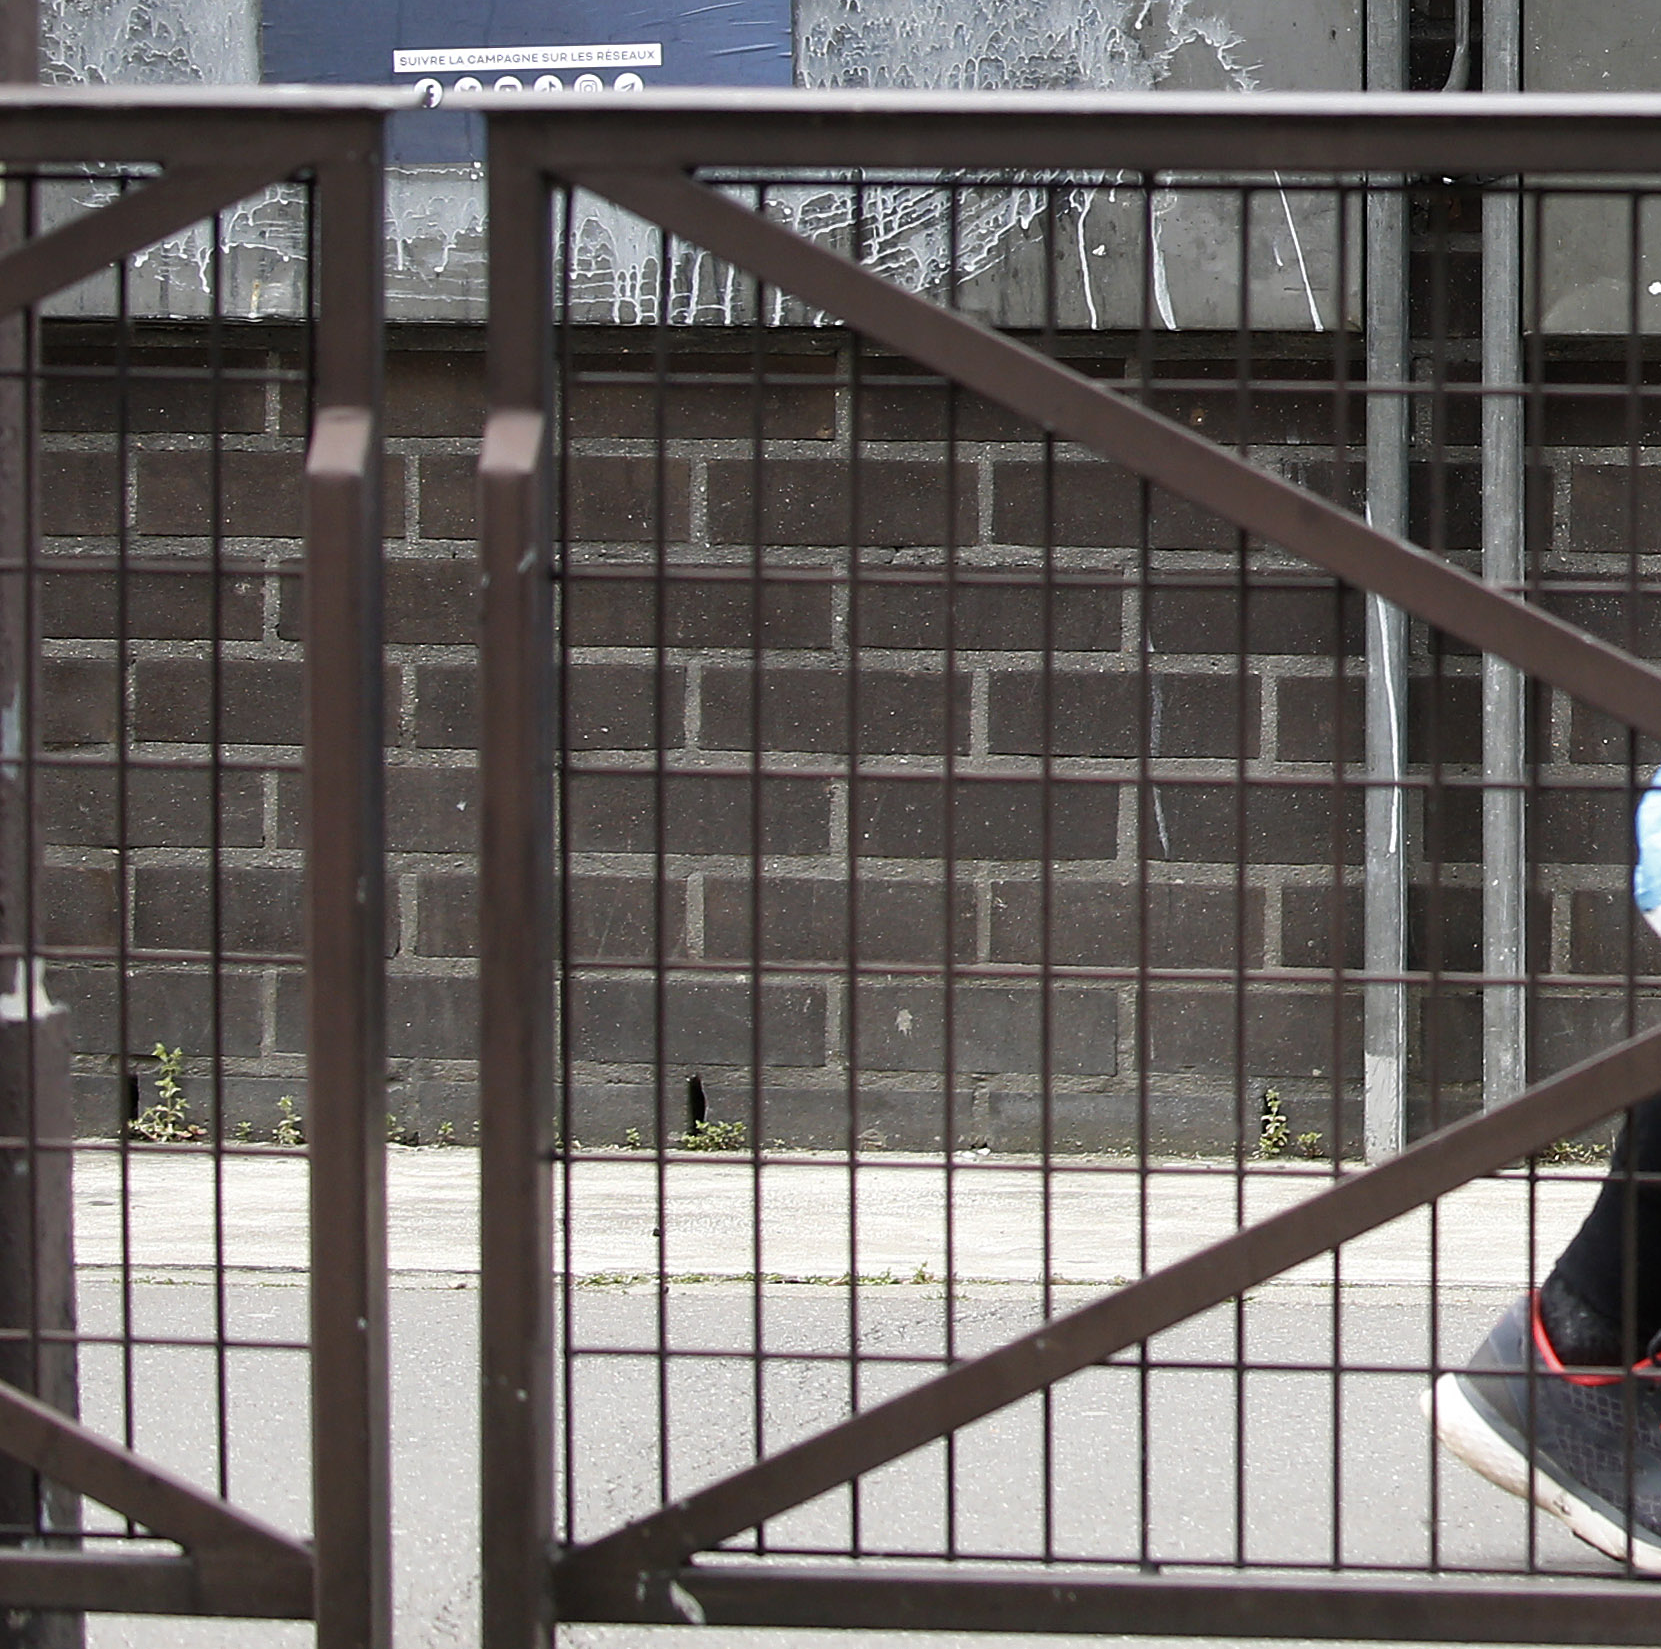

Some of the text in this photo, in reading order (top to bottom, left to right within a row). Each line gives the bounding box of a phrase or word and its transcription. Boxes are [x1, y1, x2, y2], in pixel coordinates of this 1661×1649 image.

[399, 50, 655, 67] SUIVRE LA CAMPAGNE SUR LES RÉSEAUX
